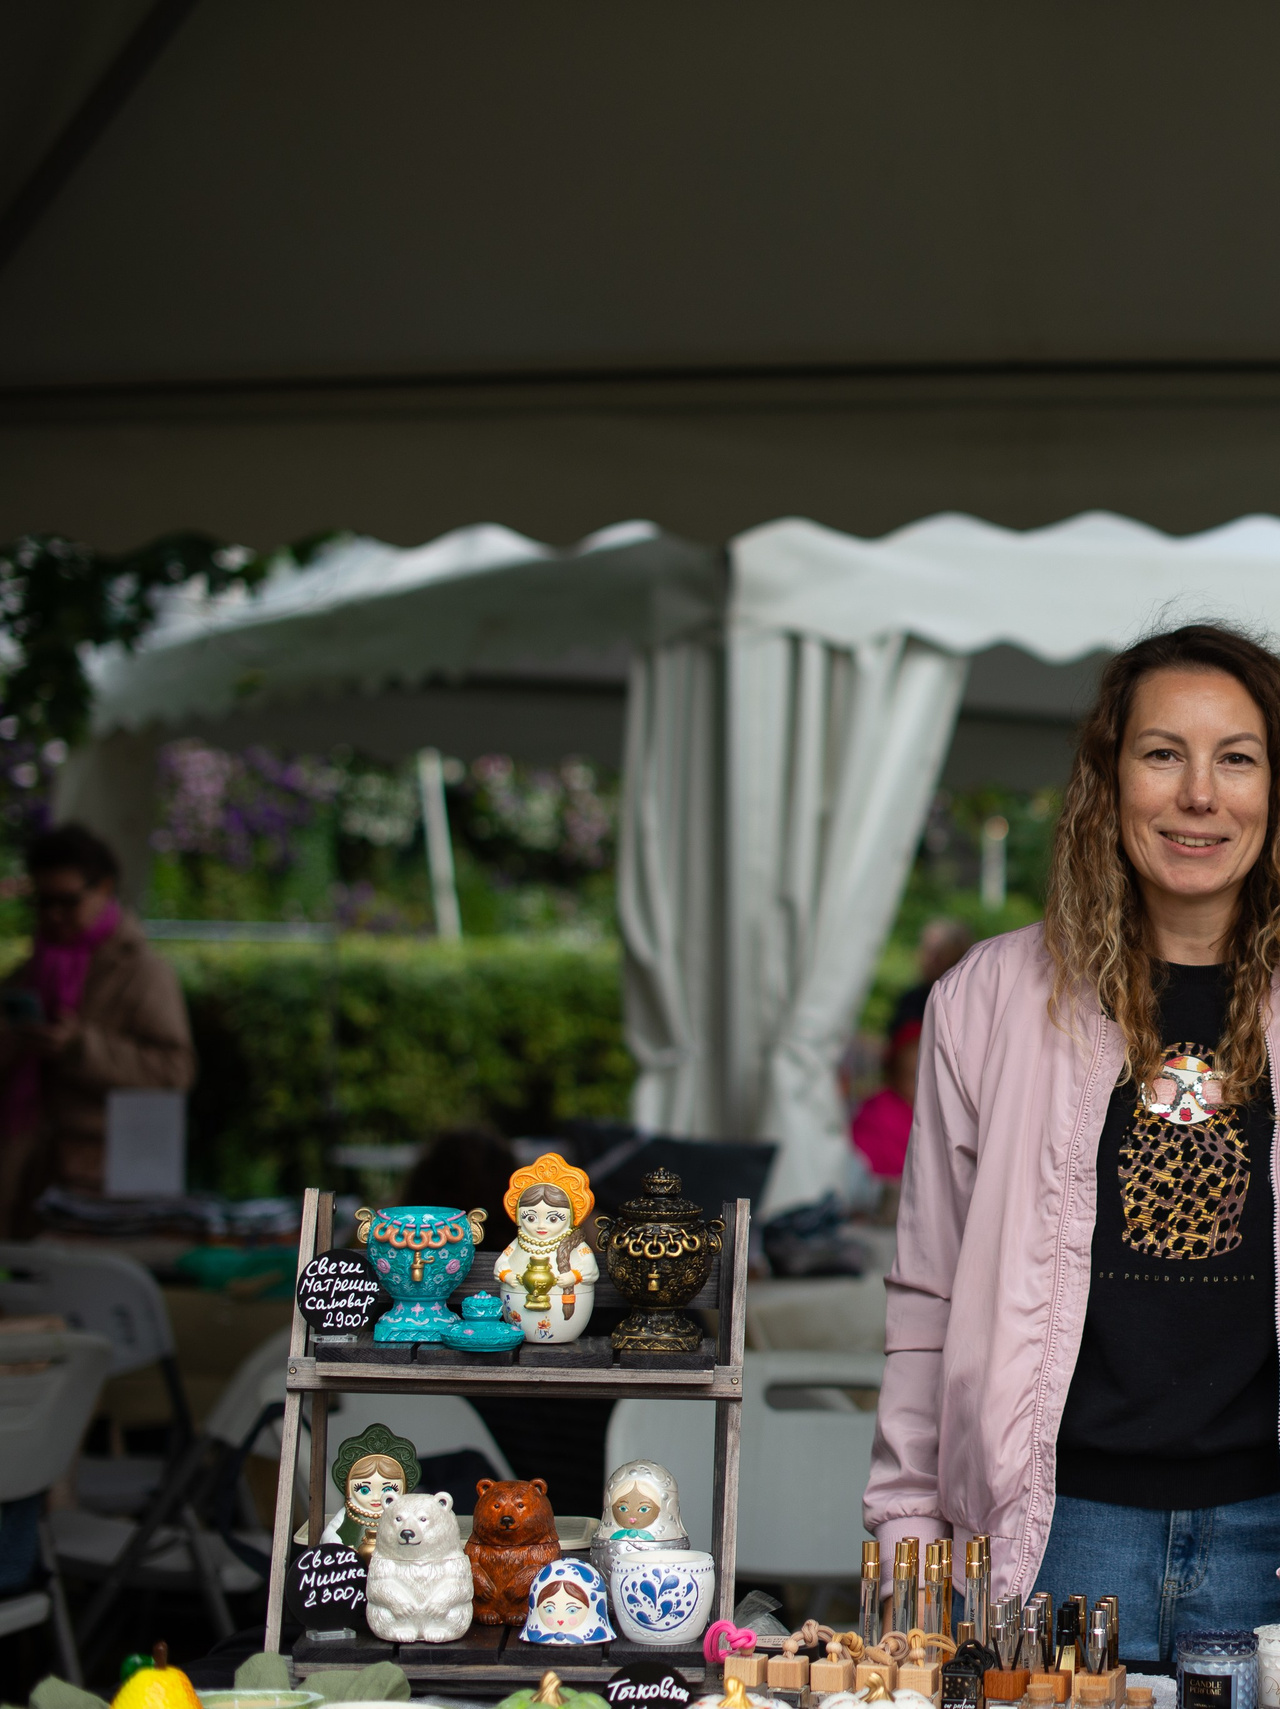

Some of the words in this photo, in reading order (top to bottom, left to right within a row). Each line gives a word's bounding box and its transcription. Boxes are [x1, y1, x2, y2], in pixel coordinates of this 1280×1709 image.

[305, 1256, 365, 1277] Свечи
[1099, 1271, 1114, 1279] BE
[1124, 1273, 1170, 1282] PROUD
[1179, 1275, 1195, 1283] OF
[1203, 1274, 1255, 1283] RUSSIA
[299, 1277, 380, 1299] Матрешка
[298, 1549, 358, 1571] Свеча
[299, 1568, 368, 1591] Мишка
[607, 1676, 690, 1702] Тыковки
[1189, 1679, 1222, 1689] CANDLE
[1189, 1686, 1222, 1696] PERFUME
